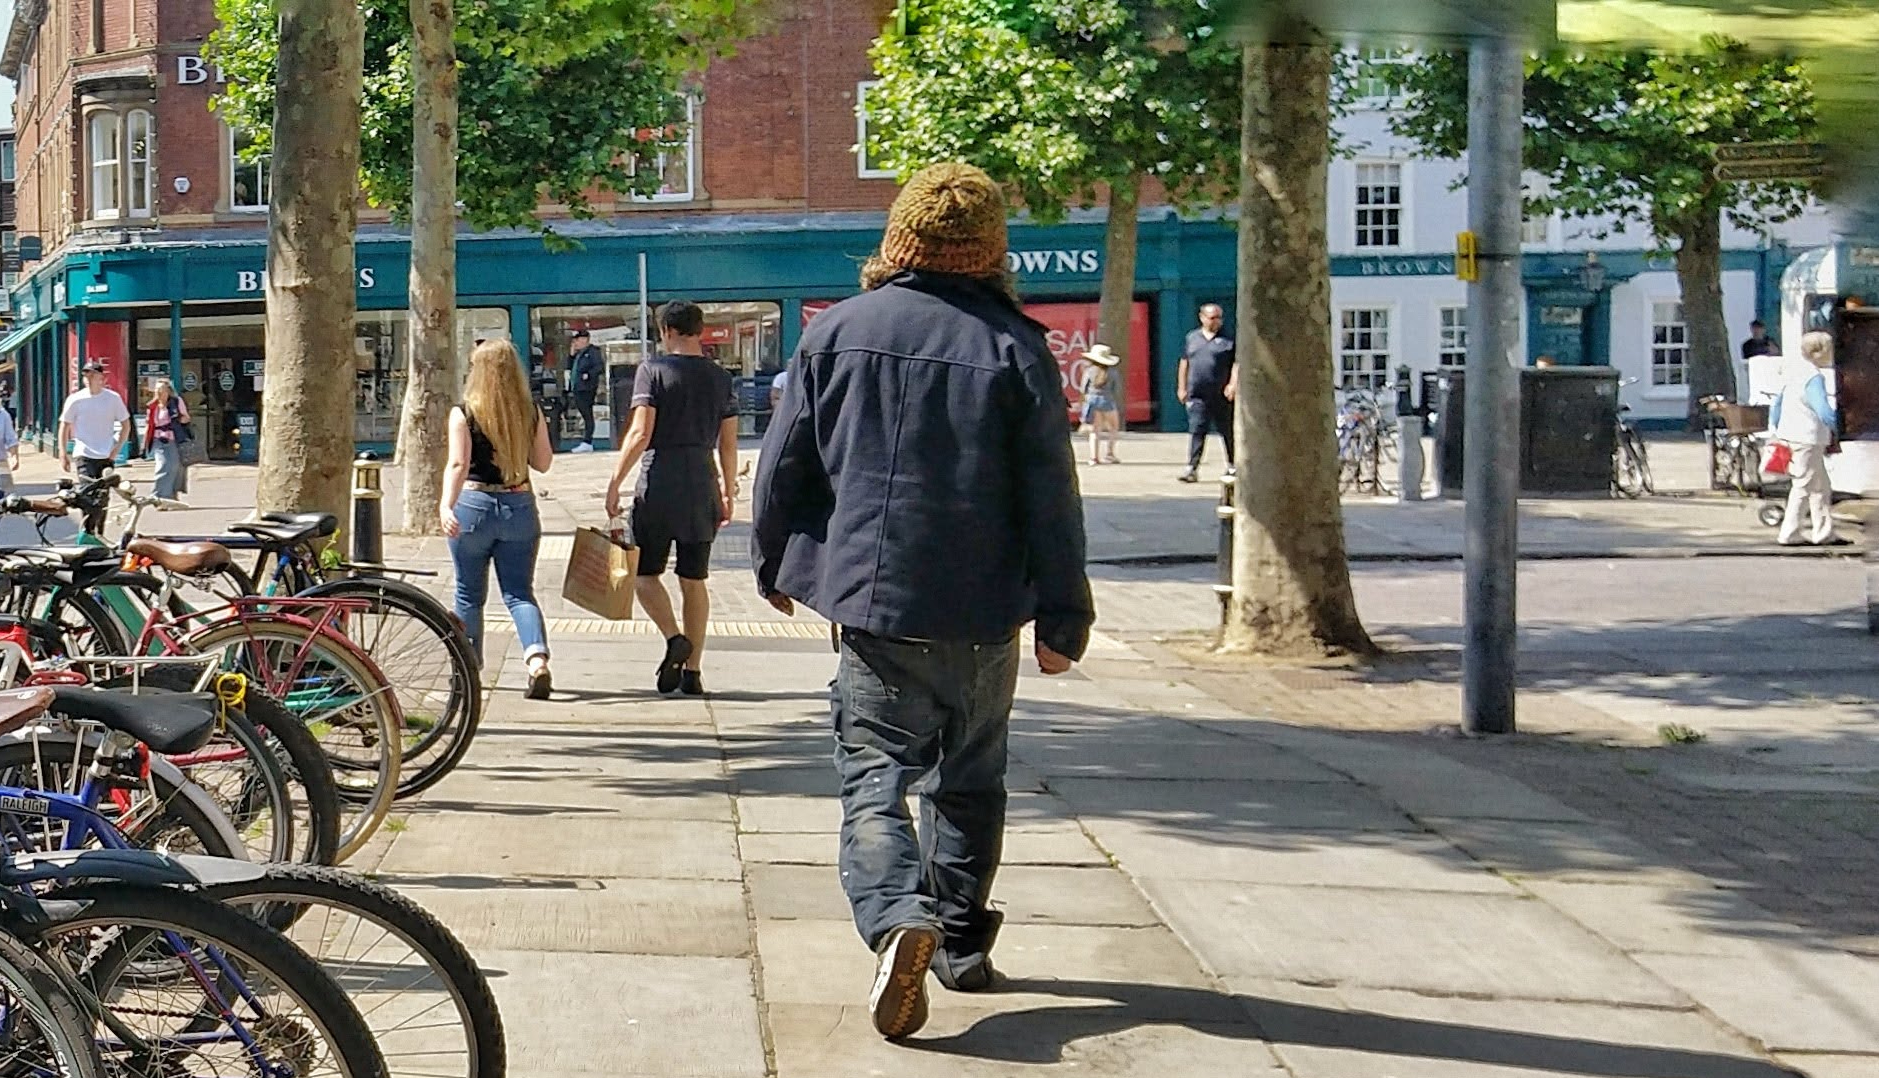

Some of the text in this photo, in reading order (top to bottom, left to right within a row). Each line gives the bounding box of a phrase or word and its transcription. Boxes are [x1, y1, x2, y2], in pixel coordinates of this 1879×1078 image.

[1005, 250, 1099, 273] OWNS
[1046, 330, 1097, 356] SAL
[3, 797, 47, 813] RALEIGH
